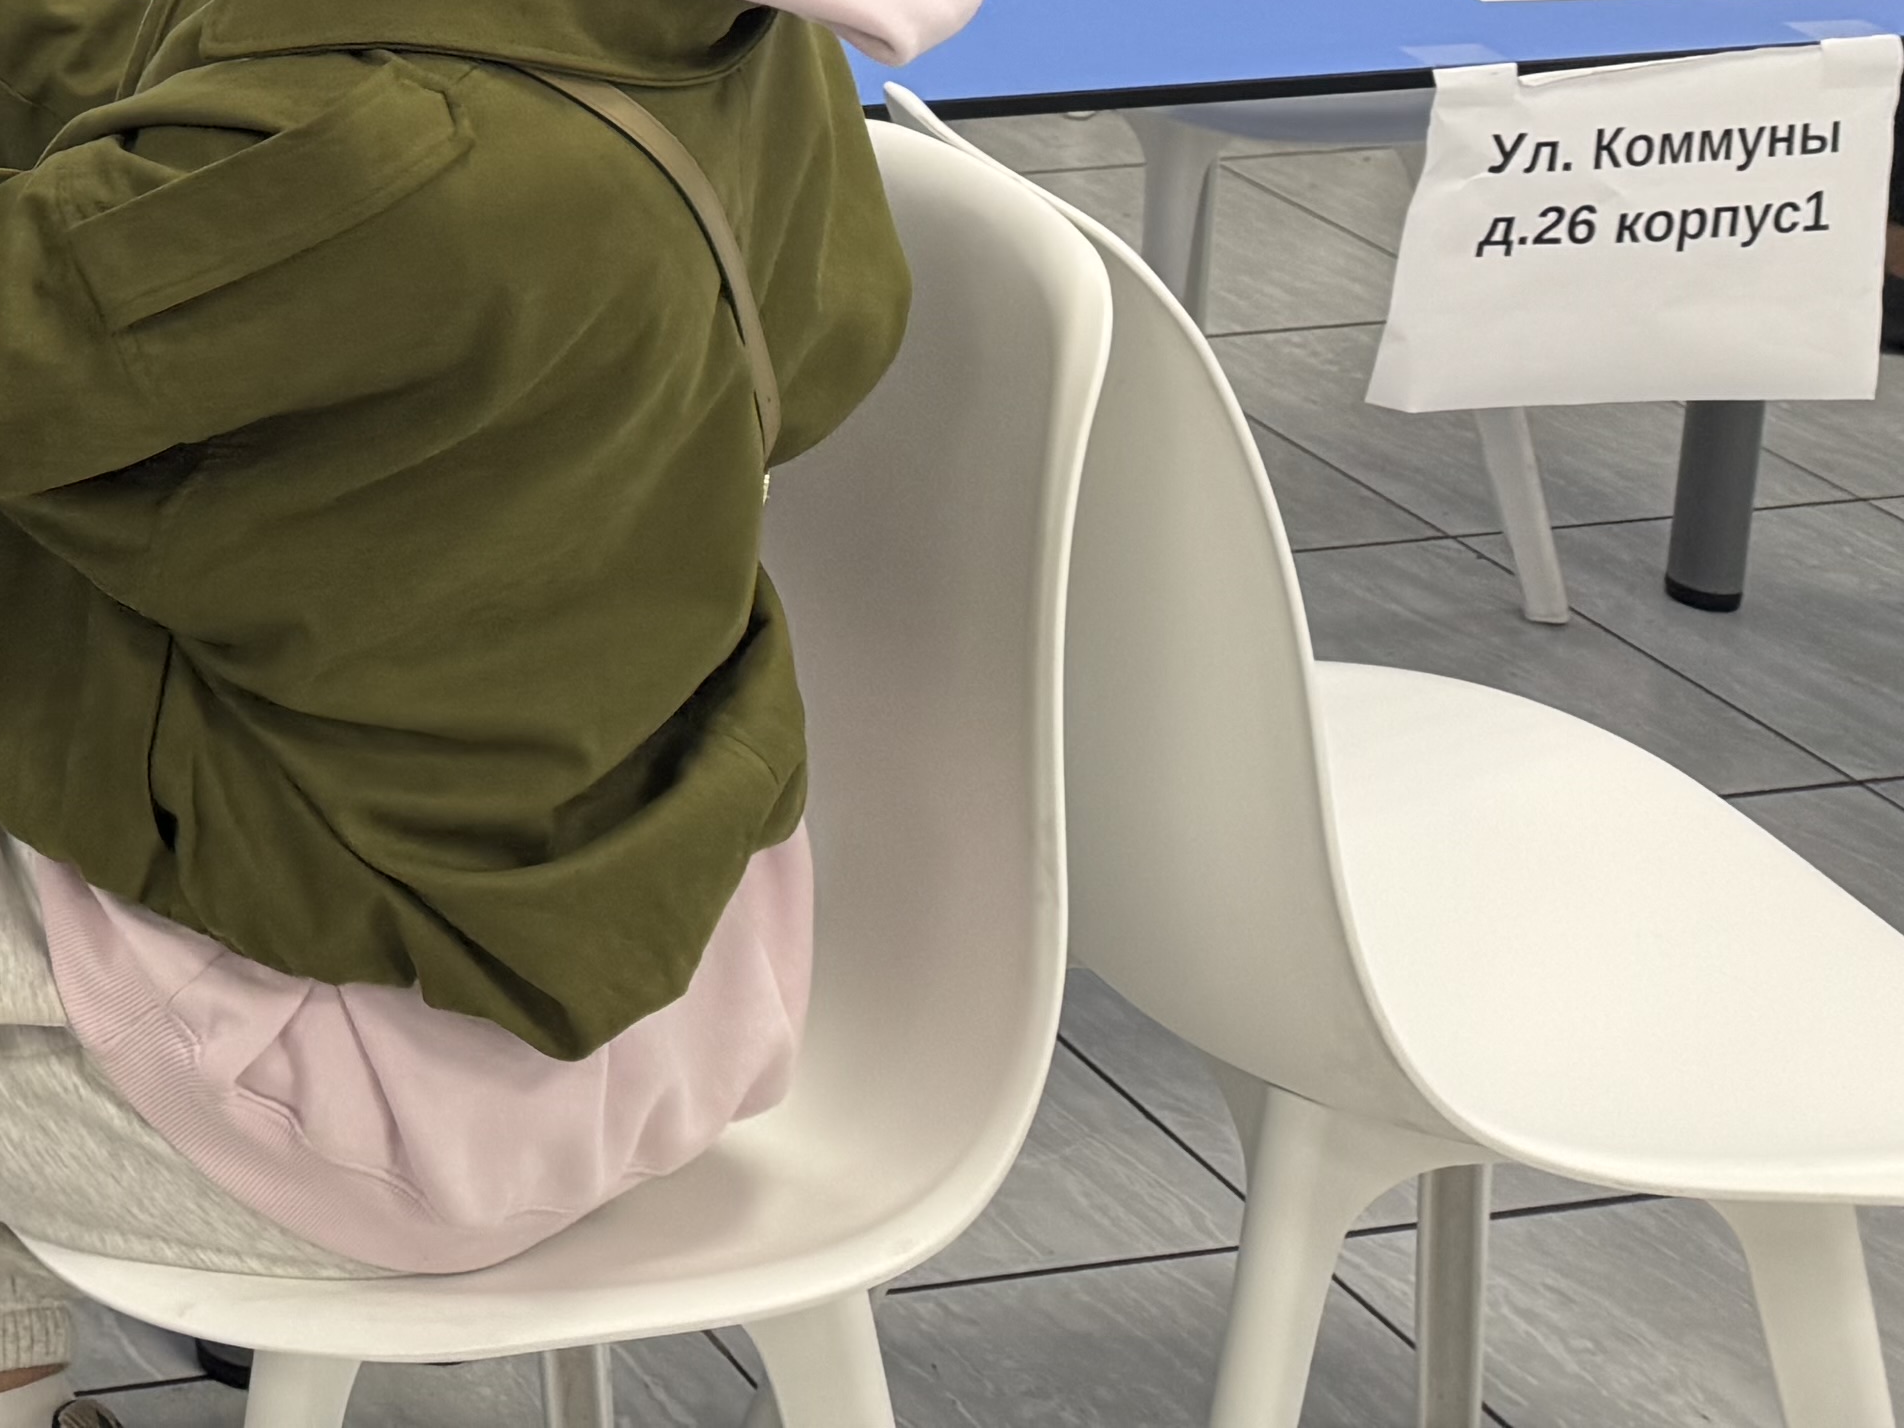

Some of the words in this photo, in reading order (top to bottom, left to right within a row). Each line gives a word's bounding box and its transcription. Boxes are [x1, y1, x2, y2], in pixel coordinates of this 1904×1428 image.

[1487, 132, 1573, 174] Ул.
[1593, 120, 1841, 172] Коммуны
[1475, 202, 1597, 258] д.26
[1615, 190, 1831, 252] корпус1
